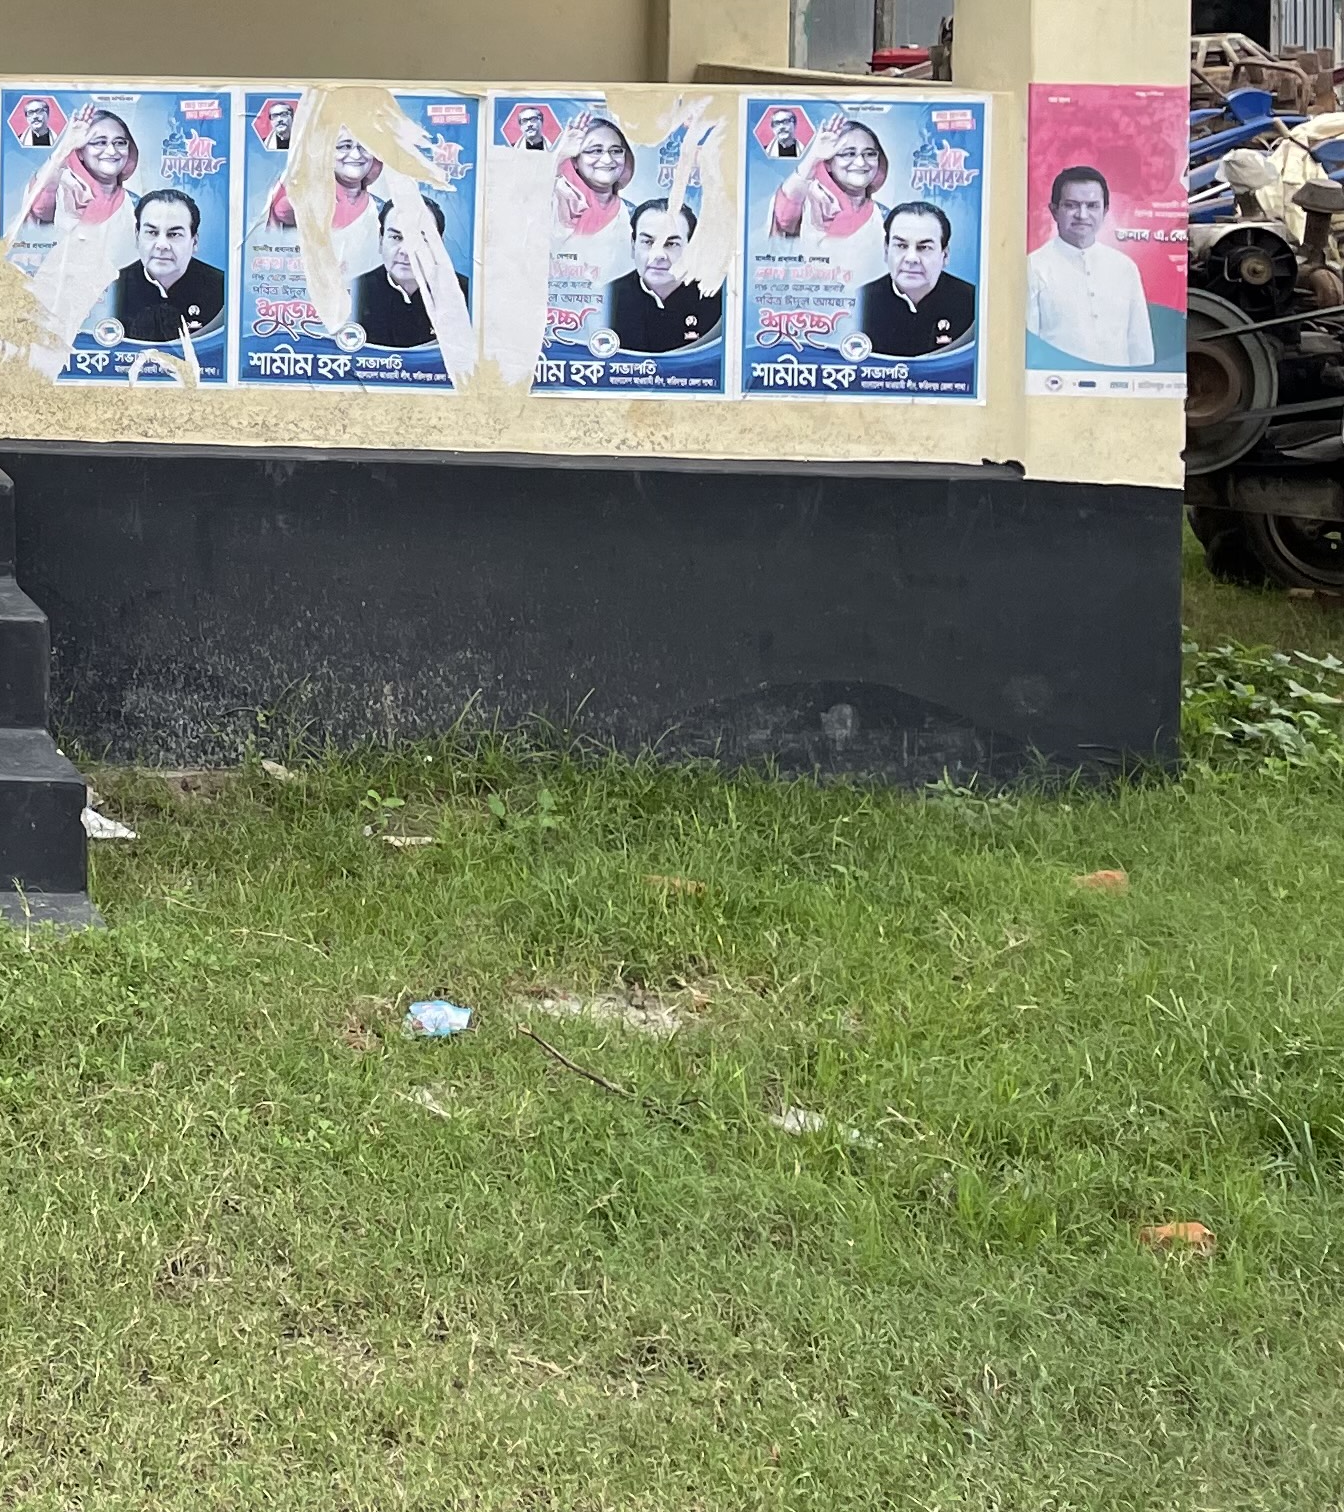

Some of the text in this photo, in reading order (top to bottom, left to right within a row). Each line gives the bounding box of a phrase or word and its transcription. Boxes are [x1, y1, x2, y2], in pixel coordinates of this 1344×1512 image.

[76, 350, 110, 374] হক
[248, 344, 403, 379] শামীম হক সভাপতি
[570, 361, 605, 385] হক
[609, 359, 657, 375] সভাপতি
[751, 354, 909, 390] শামীম হক সভাপতি
